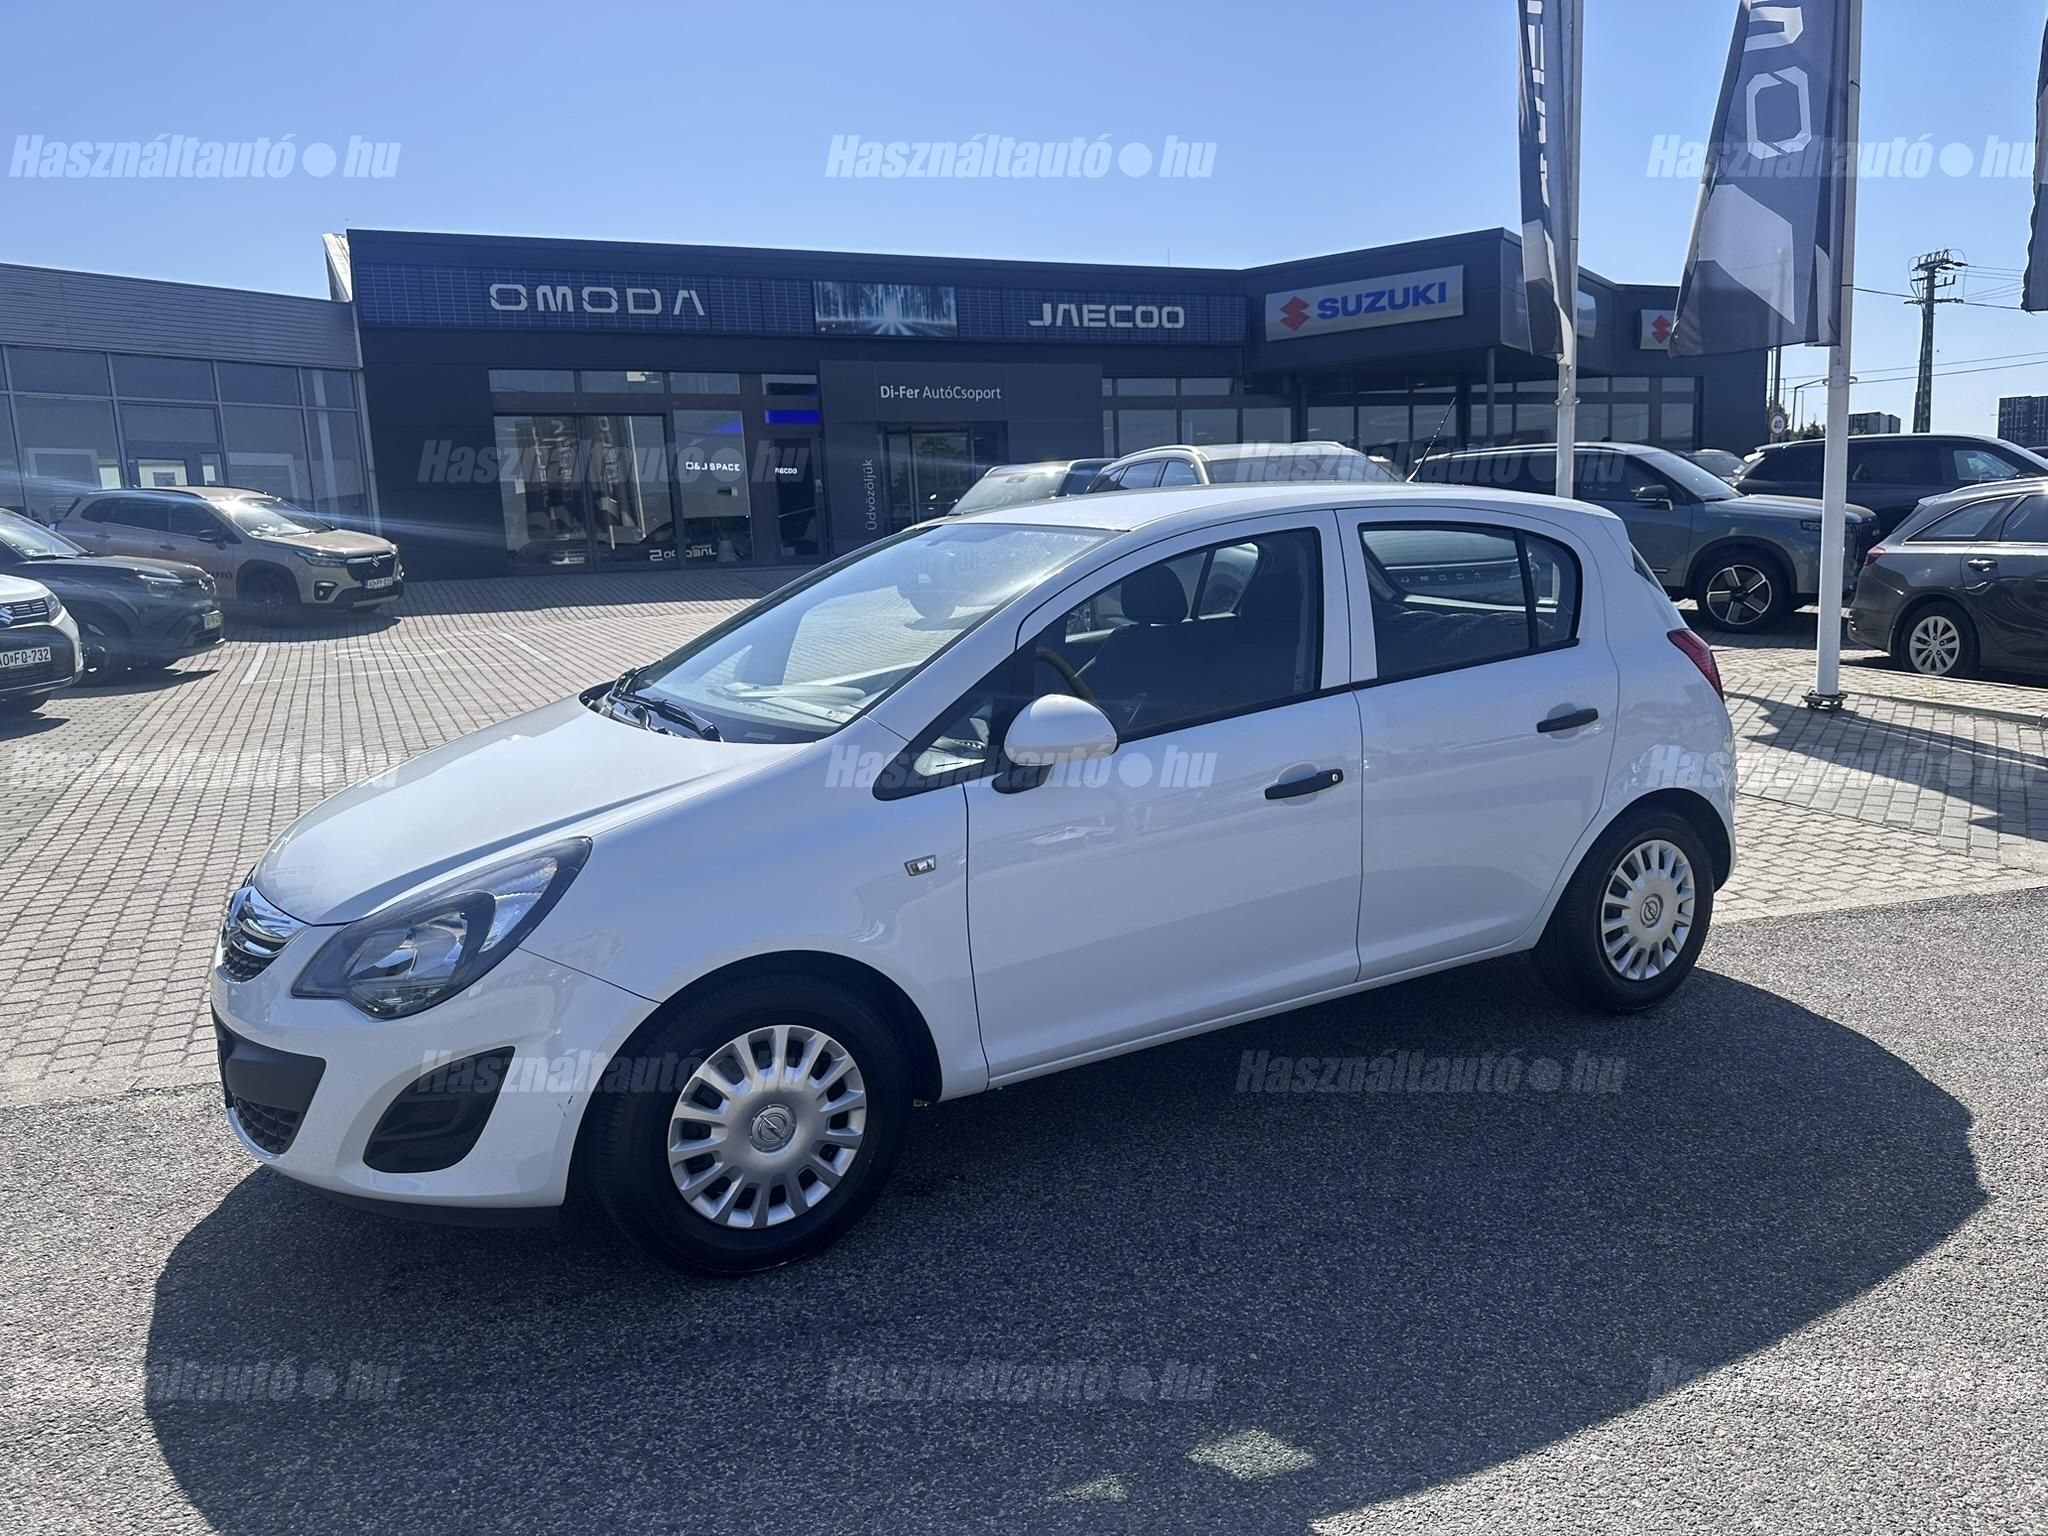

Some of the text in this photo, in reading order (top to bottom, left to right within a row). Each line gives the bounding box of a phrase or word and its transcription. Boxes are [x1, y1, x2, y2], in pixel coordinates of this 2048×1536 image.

[490, 284, 705, 316] OMODA
[1317, 281, 1446, 320] SUZUKI
[1027, 303, 1185, 328] JAECOO
[880, 385, 1002, 401] Di-Fer AutóCsoport
[709, 462, 740, 471] SPACE
